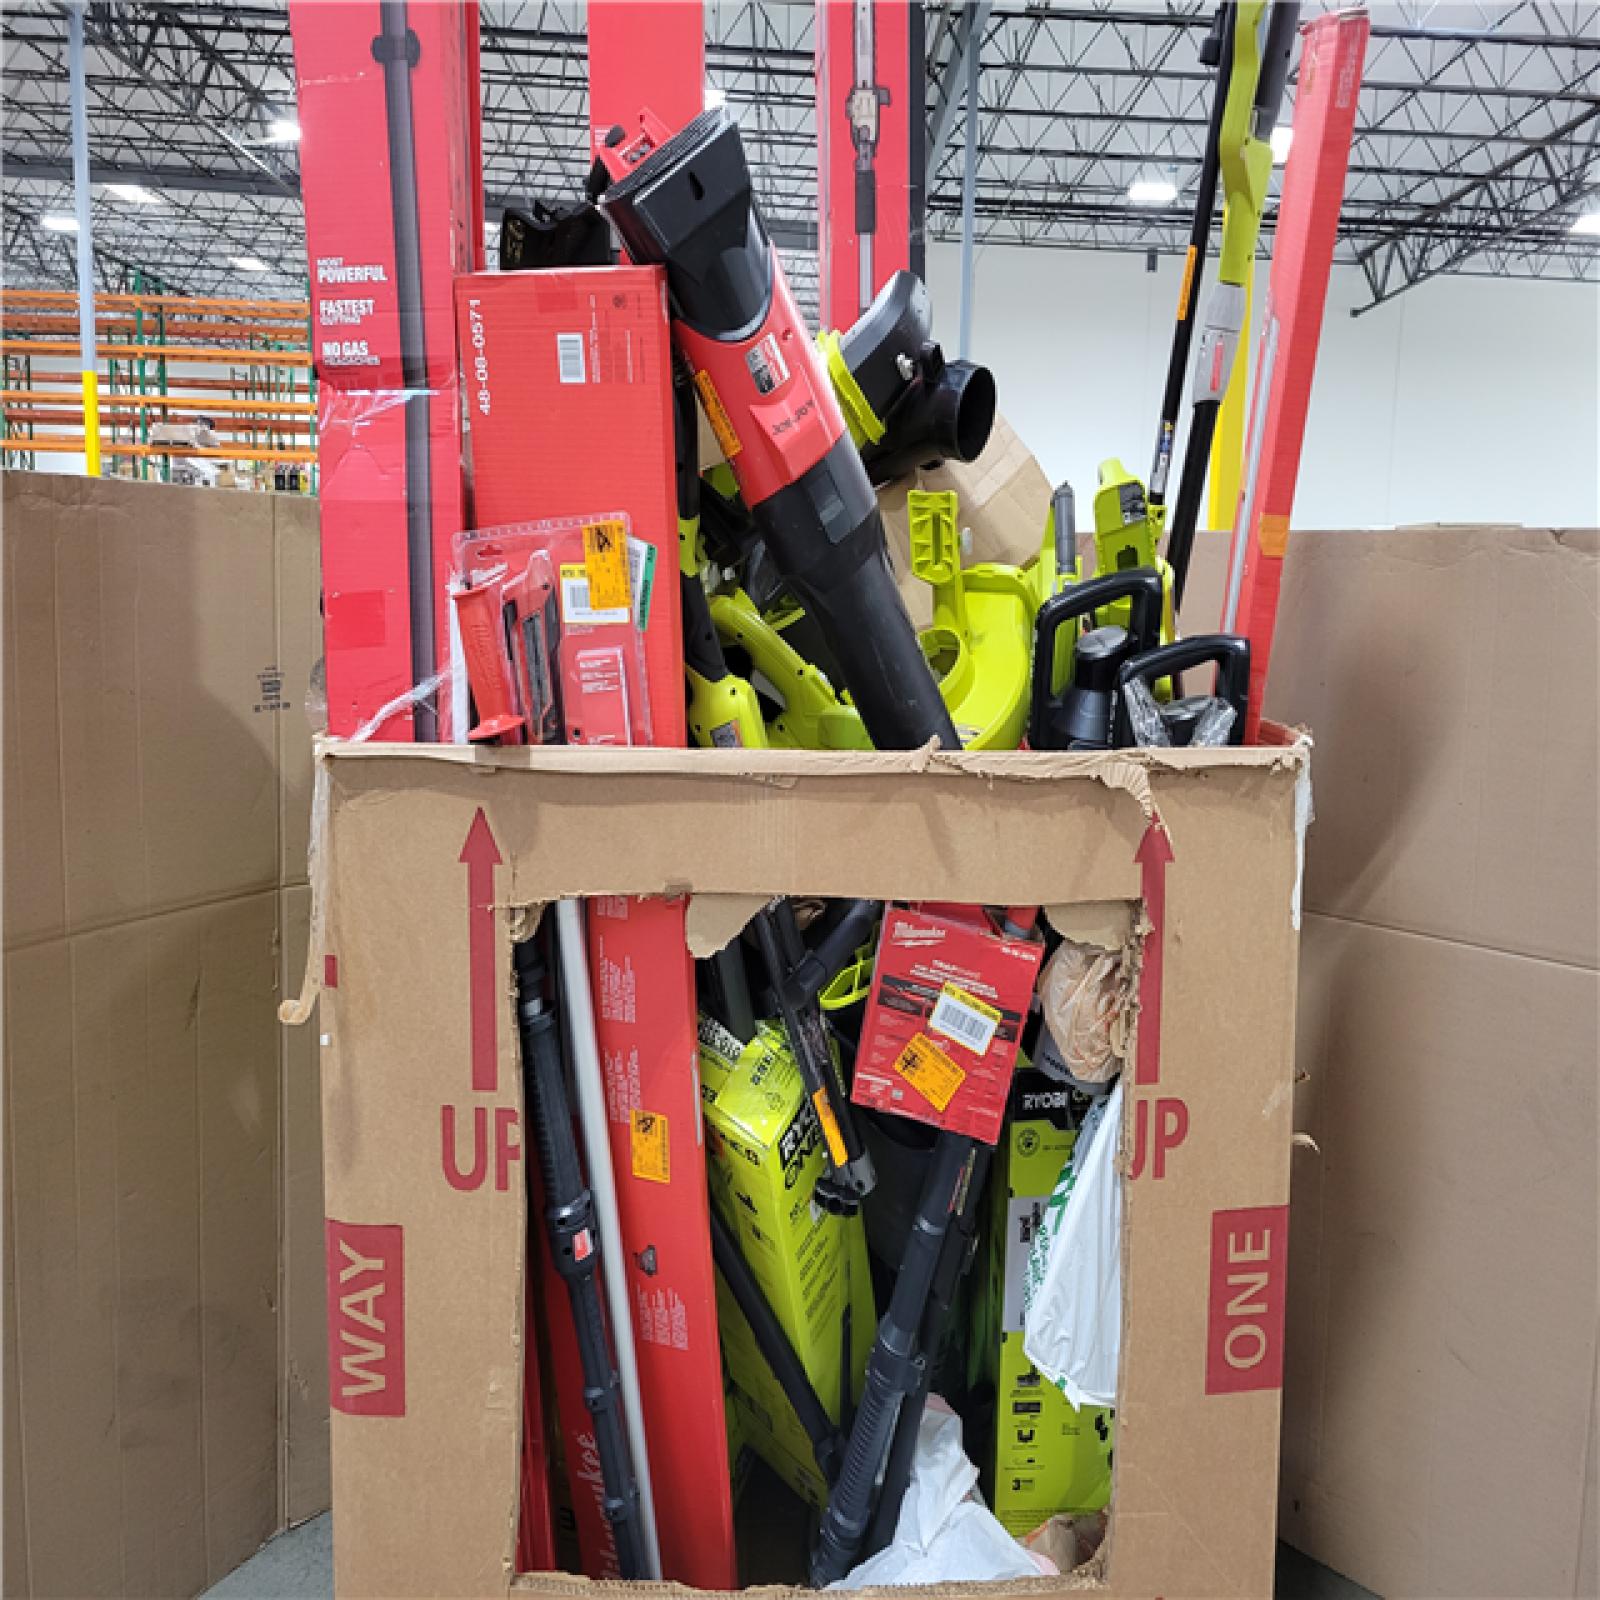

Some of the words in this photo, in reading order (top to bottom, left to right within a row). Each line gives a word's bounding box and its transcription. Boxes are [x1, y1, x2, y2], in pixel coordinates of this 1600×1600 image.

[317, 265, 388, 283] POWERFUL
[319, 299, 375, 315] FASTEST
[322, 341, 342, 356] NO
[343, 340, 368, 356] GAS
[1023, 1091, 1068, 1110] RYOBI
[1224, 1229, 1271, 1369] ONE
[339, 1239, 385, 1397] WAY
